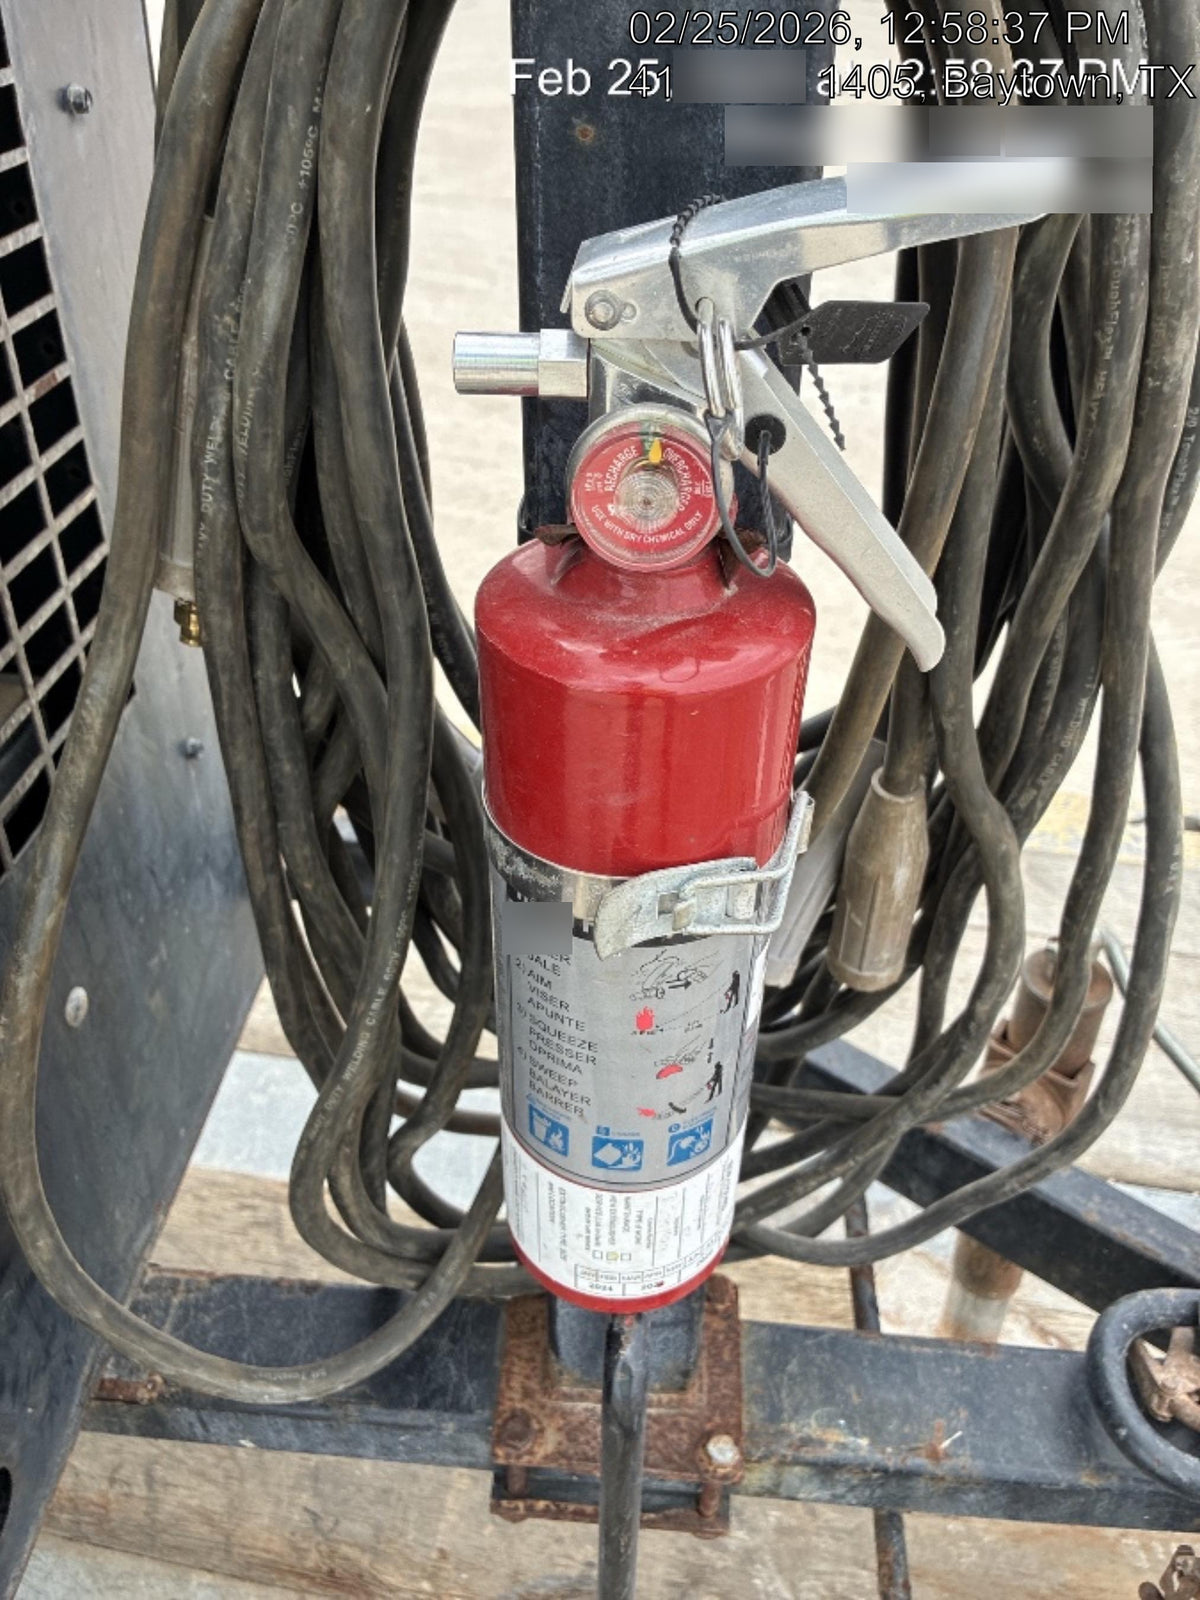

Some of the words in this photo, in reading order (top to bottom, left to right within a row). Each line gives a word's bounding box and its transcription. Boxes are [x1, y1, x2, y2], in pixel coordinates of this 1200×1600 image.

[643, 527, 686, 543] CHEMICAL
[527, 970, 552, 990] AIM
[527, 980, 570, 1012] VISER
[528, 997, 586, 1032] APUNTE
[529, 1013, 599, 1054] SQUEEZE
[529, 1026, 597, 1067] PRESSER
[529, 1040, 583, 1075] OPRIMA
[529, 1055, 579, 1087] SWEEP
[529, 1067, 592, 1107] BALAYER
[529, 1080, 584, 1118] BARRER
